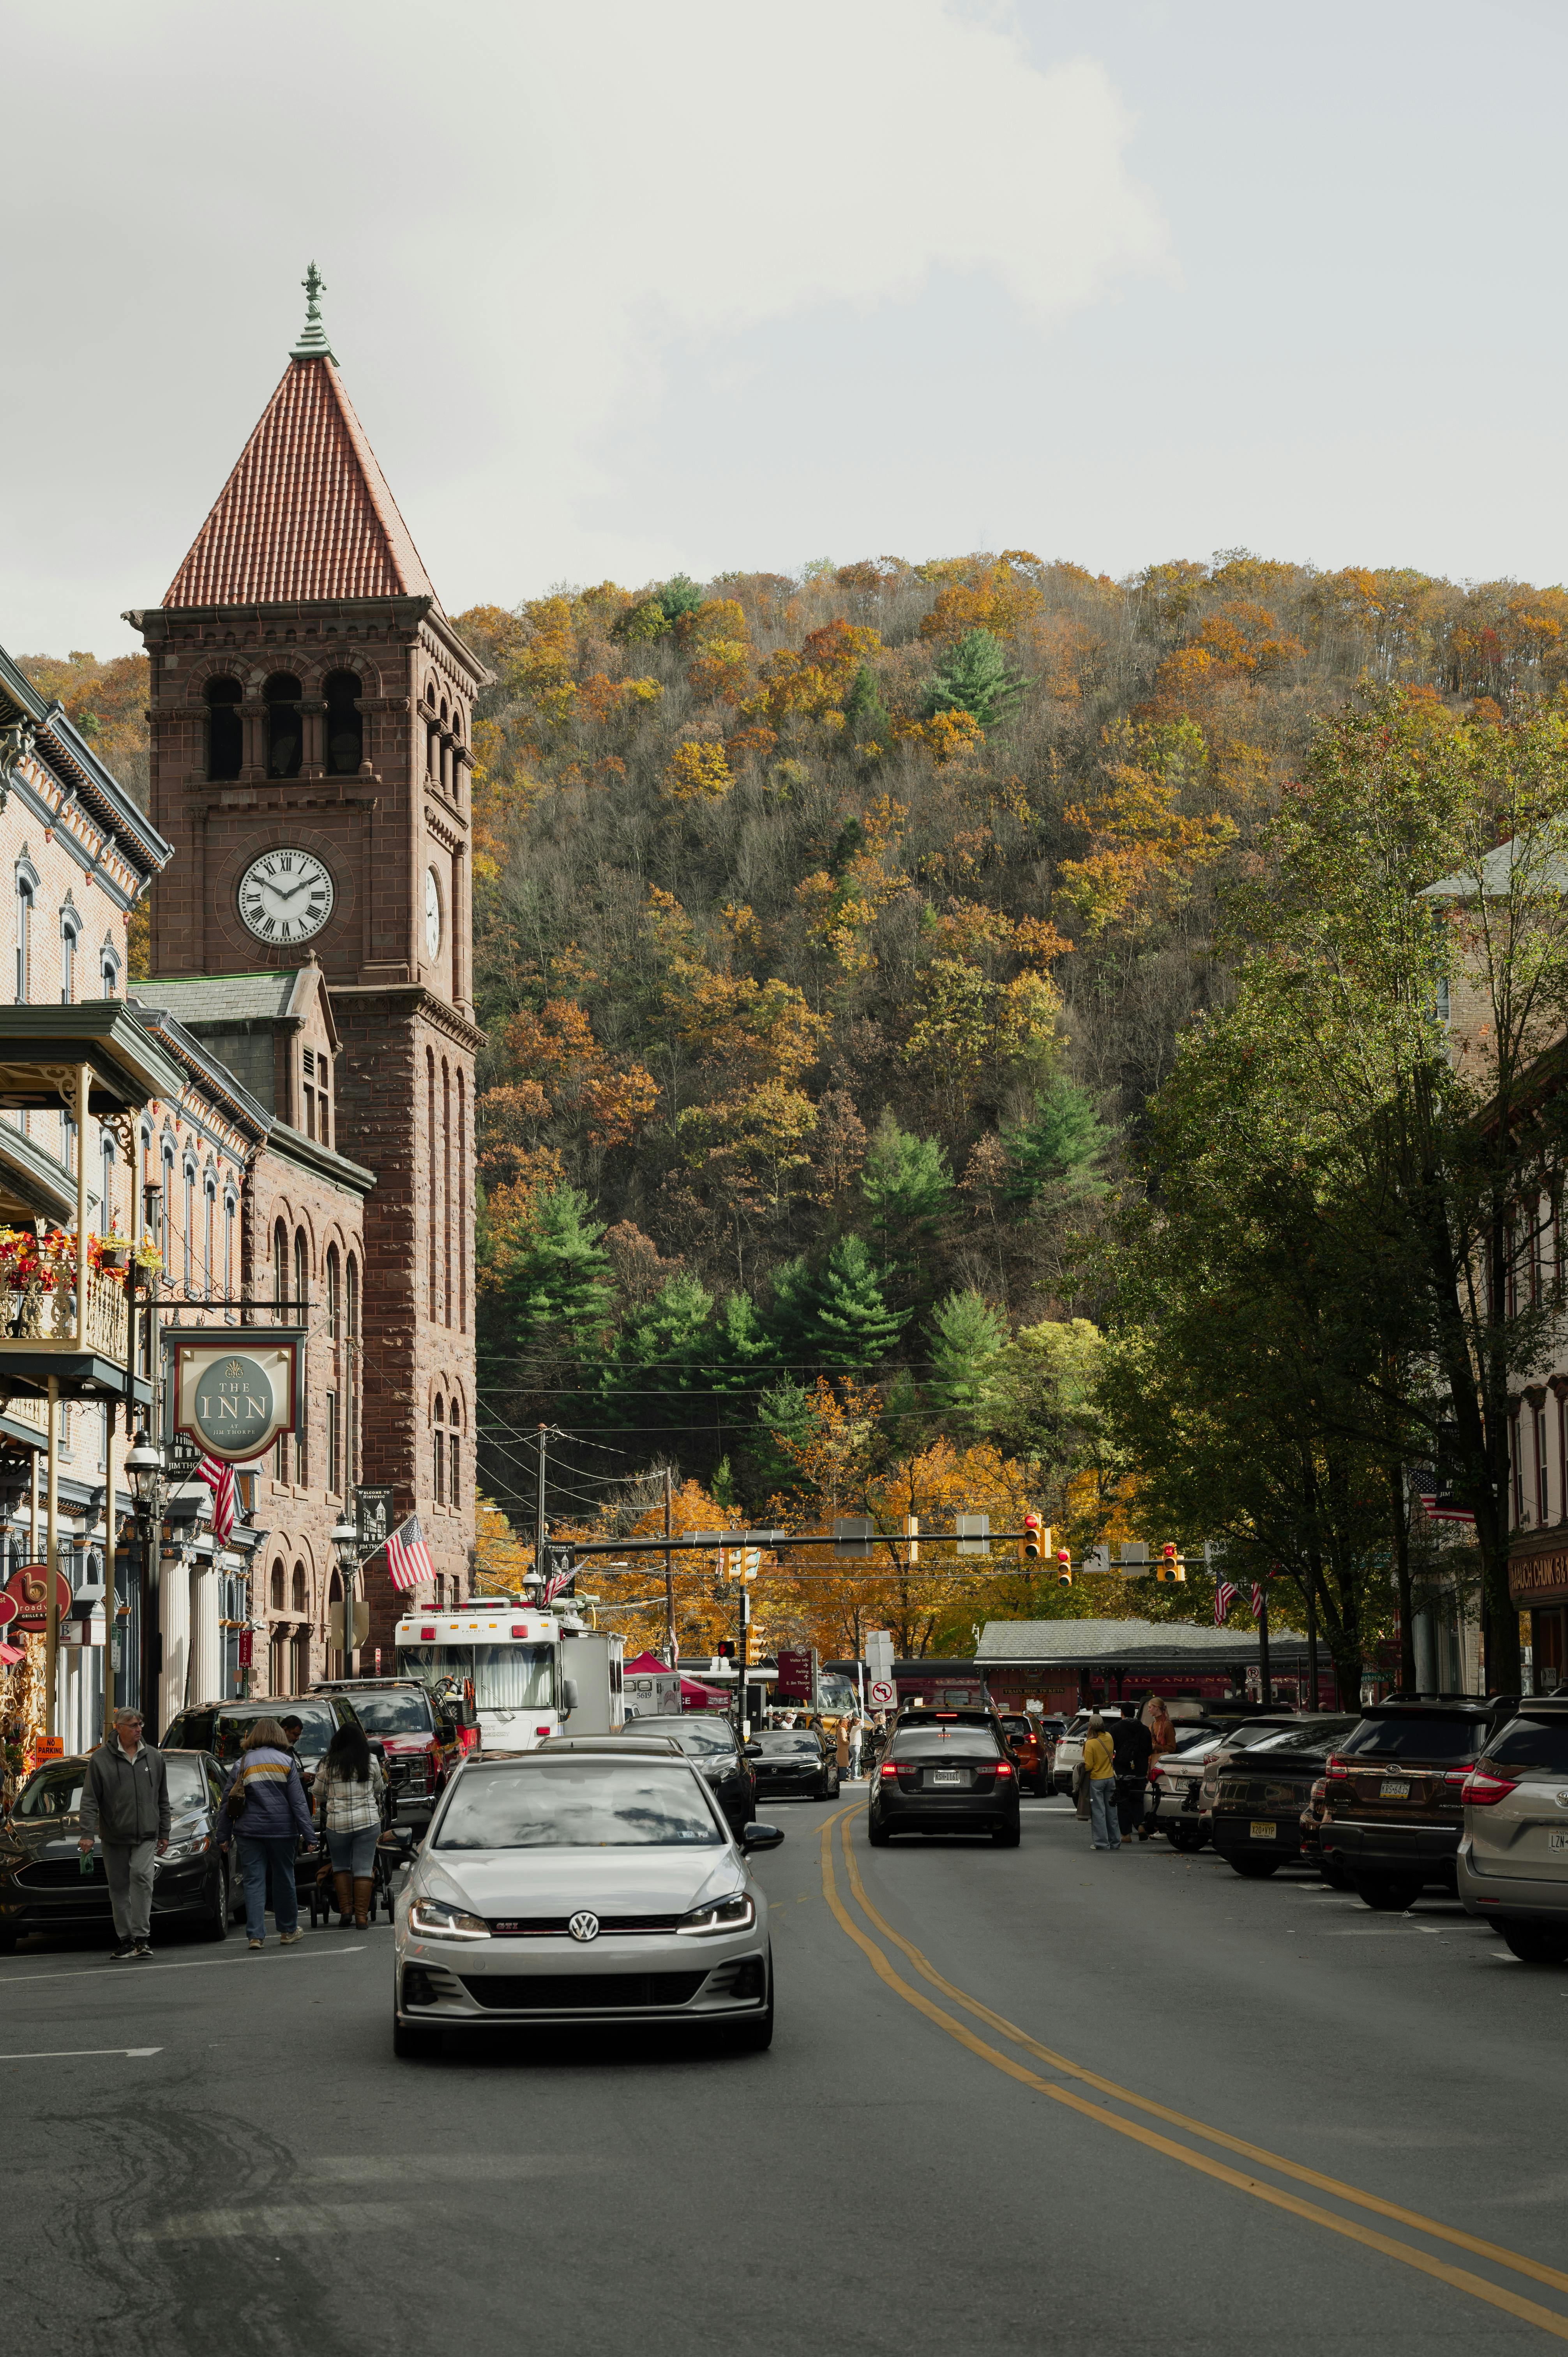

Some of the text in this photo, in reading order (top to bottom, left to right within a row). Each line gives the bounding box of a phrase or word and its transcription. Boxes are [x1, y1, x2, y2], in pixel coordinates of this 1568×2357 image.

[280, 857, 292, 872] XII
[219, 1383, 250, 1392] THE
[200, 1396, 268, 1419] INN
[168, 1462, 180, 1471] JIM
[1512, 1562, 1533, 1590] MAUCH
[1534, 1558, 1554, 1587] CHUNK
